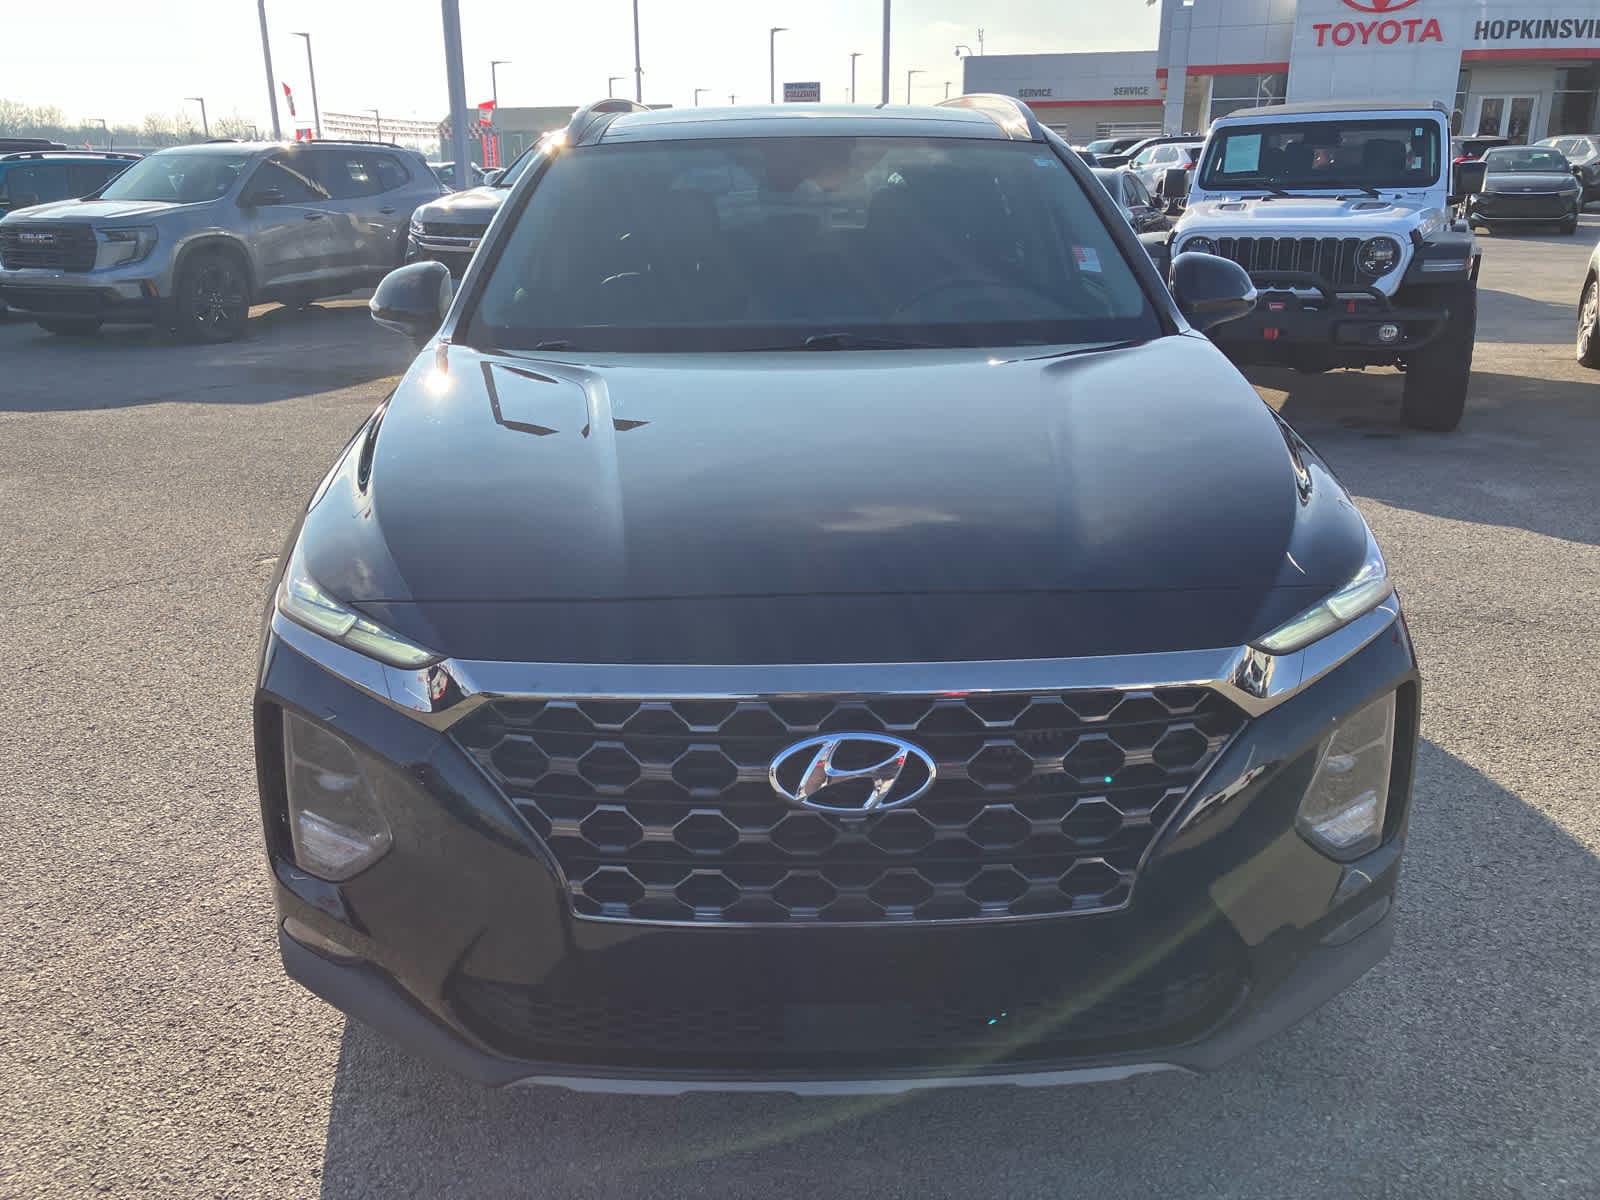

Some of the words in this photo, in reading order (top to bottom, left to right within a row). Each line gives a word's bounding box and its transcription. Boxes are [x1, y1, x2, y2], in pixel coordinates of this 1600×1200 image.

[1313, 18, 1443, 47] TOYOTA
[1018, 88, 1053, 98] SERVICE
[1113, 86, 1149, 96] SERVICE
